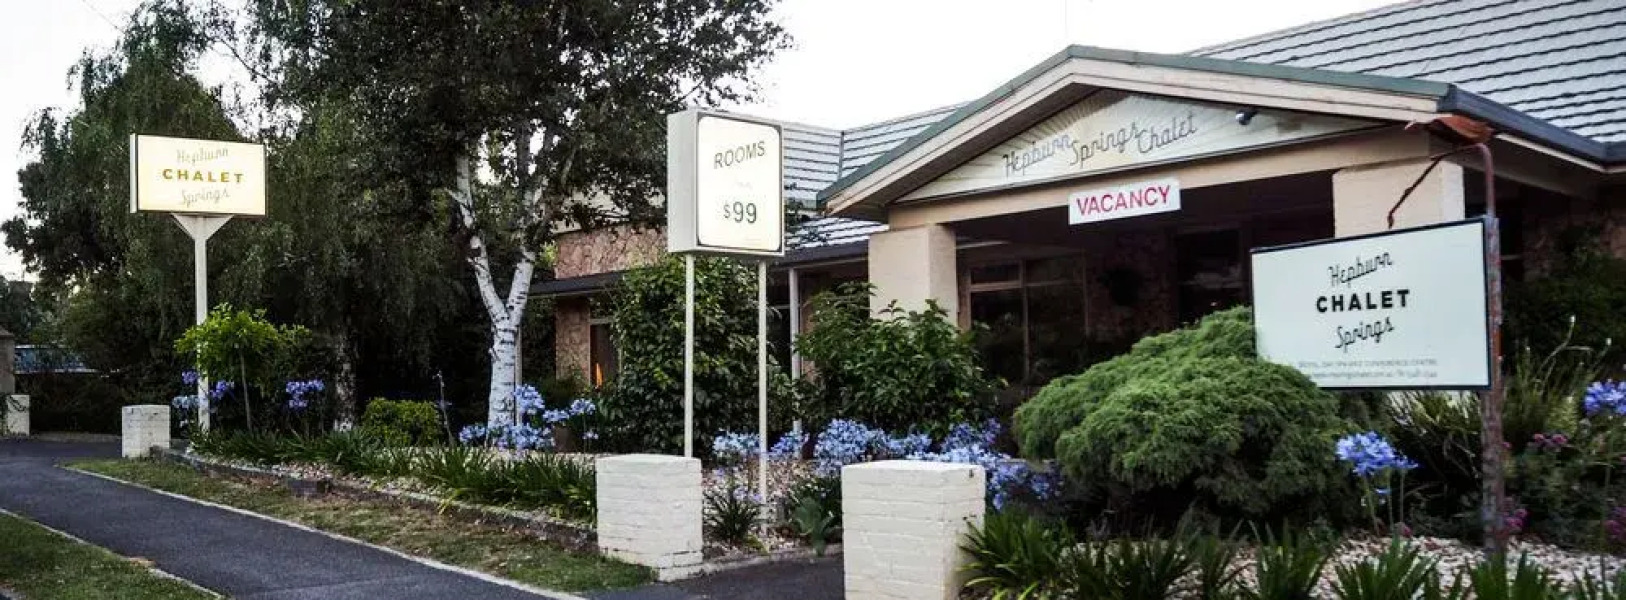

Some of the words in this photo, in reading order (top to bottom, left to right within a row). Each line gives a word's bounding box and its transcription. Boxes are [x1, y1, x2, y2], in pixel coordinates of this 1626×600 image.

[713, 140, 766, 170] ROOMS
[1002, 133, 1072, 178] Hepburn
[1070, 121, 1141, 169] Springs
[1137, 110, 1199, 154] Chalet
[162, 168, 244, 183] CHALET
[181, 188, 231, 208] Springs
[723, 201, 758, 224] $99
[1076, 184, 1171, 217] VACANCY
[1327, 251, 1394, 288] Hepburn
[1315, 289, 1411, 313] CHALET
[1334, 316, 1395, 354] Springs
